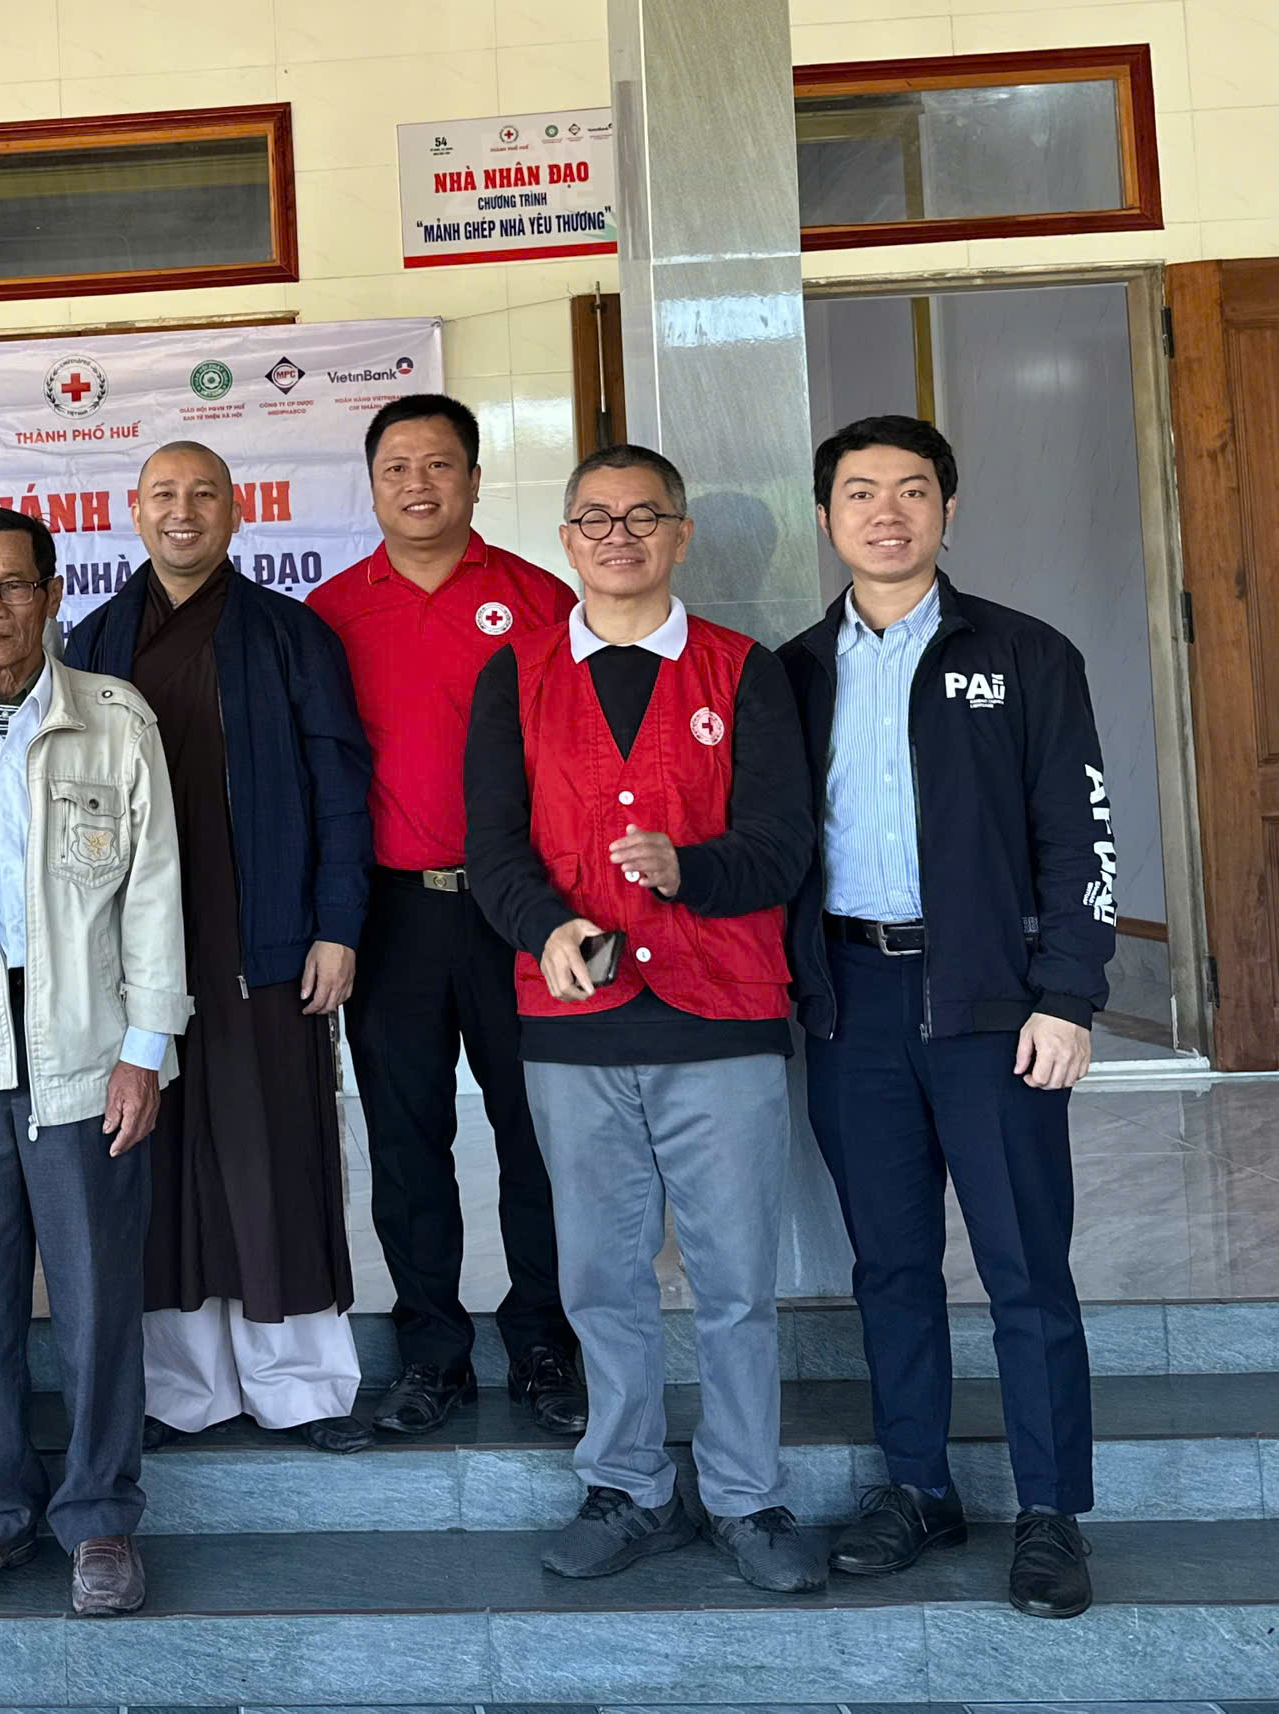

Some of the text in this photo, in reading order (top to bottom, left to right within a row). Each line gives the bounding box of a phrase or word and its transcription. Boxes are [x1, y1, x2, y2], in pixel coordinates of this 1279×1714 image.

[434, 137, 448, 148] 54
[434, 161, 590, 193] NHÀ NHÂN ĐẠO
[477, 192, 547, 211] CHƯƠNG TRÌNH
[464, 215, 496, 240] GHÉP
[500, 214, 526, 238] NHÀ
[528, 213, 553, 235] YÊU
[276, 370, 296, 380] MPC
[327, 368, 397, 383] VietinBank
[15, 420, 141, 444] THÀNH PHỐ HUẾ
[66, 554, 133, 595] NHÀ
[253, 551, 322, 592] ĐẠO
